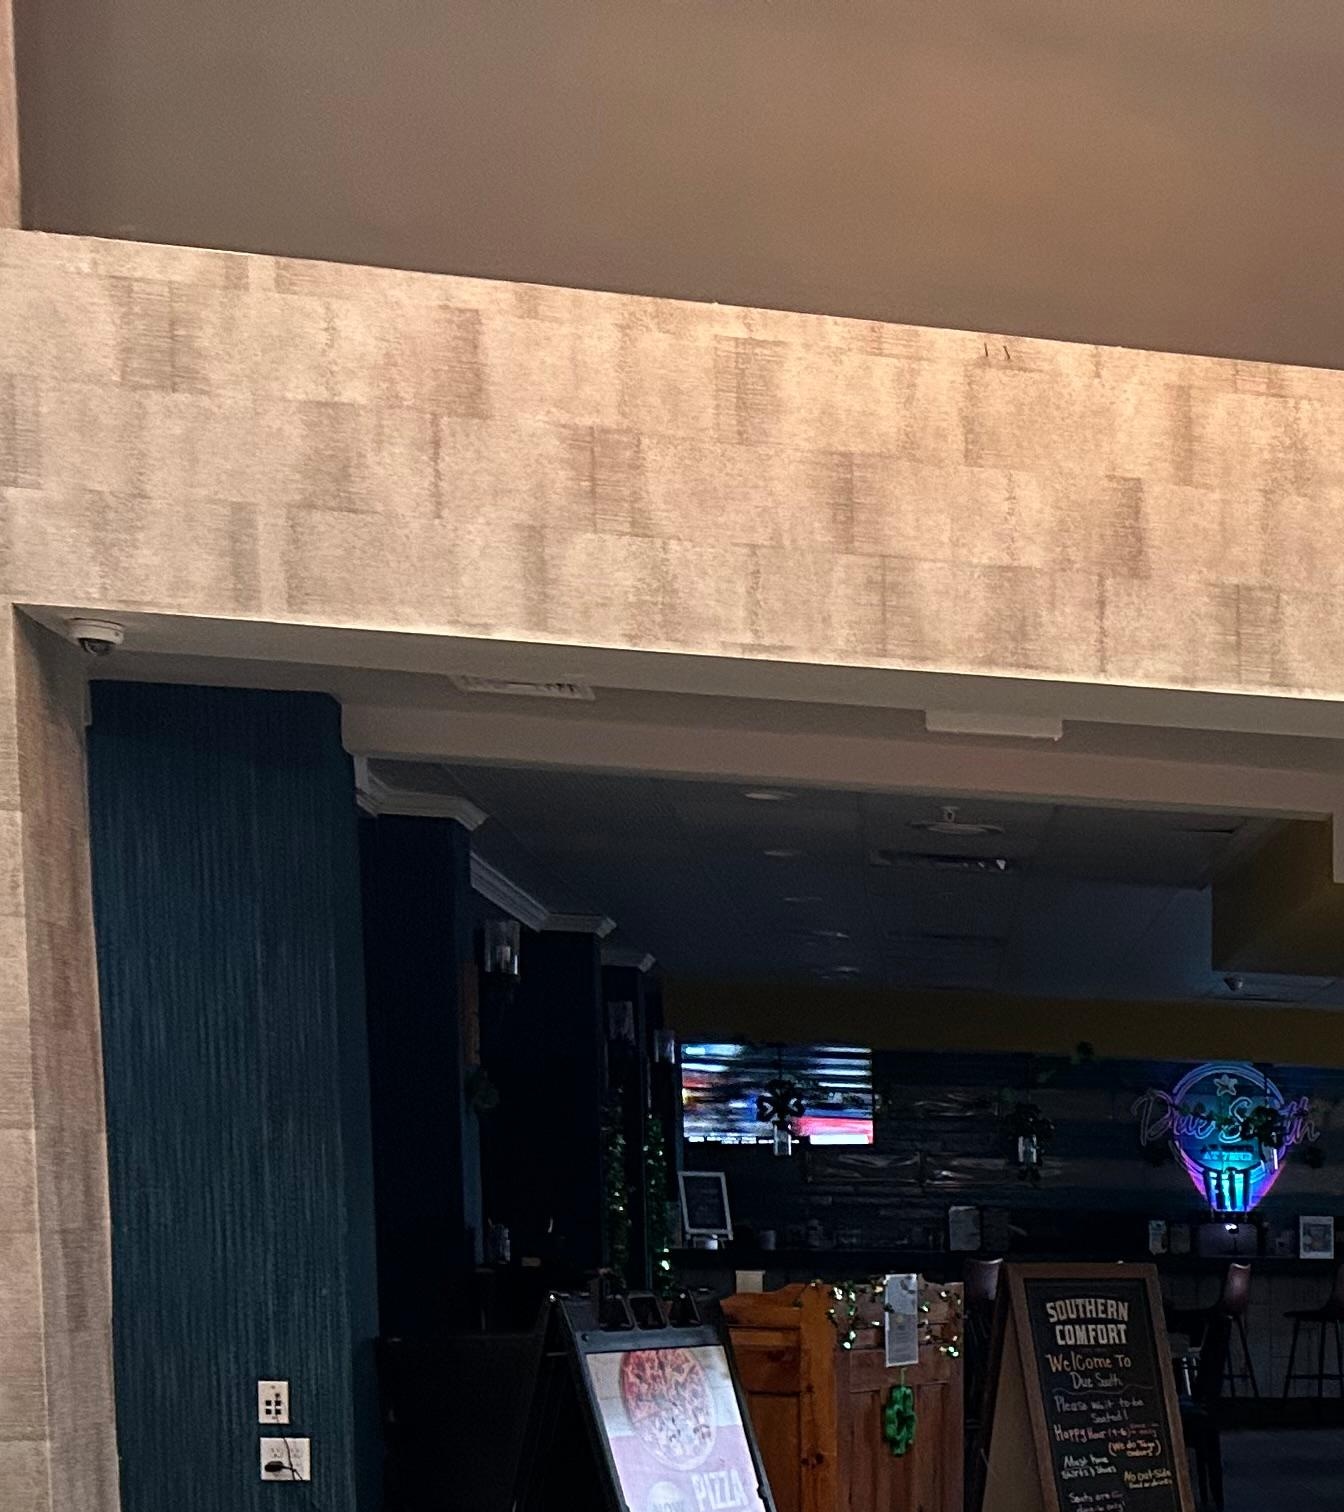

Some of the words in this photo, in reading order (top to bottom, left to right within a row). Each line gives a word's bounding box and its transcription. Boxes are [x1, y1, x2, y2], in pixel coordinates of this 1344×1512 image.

[1046, 1298, 1130, 1324] SOUTHERN
[1055, 1324, 1128, 1346] COMFORT
[691, 1469, 750, 1512] PIZZA
